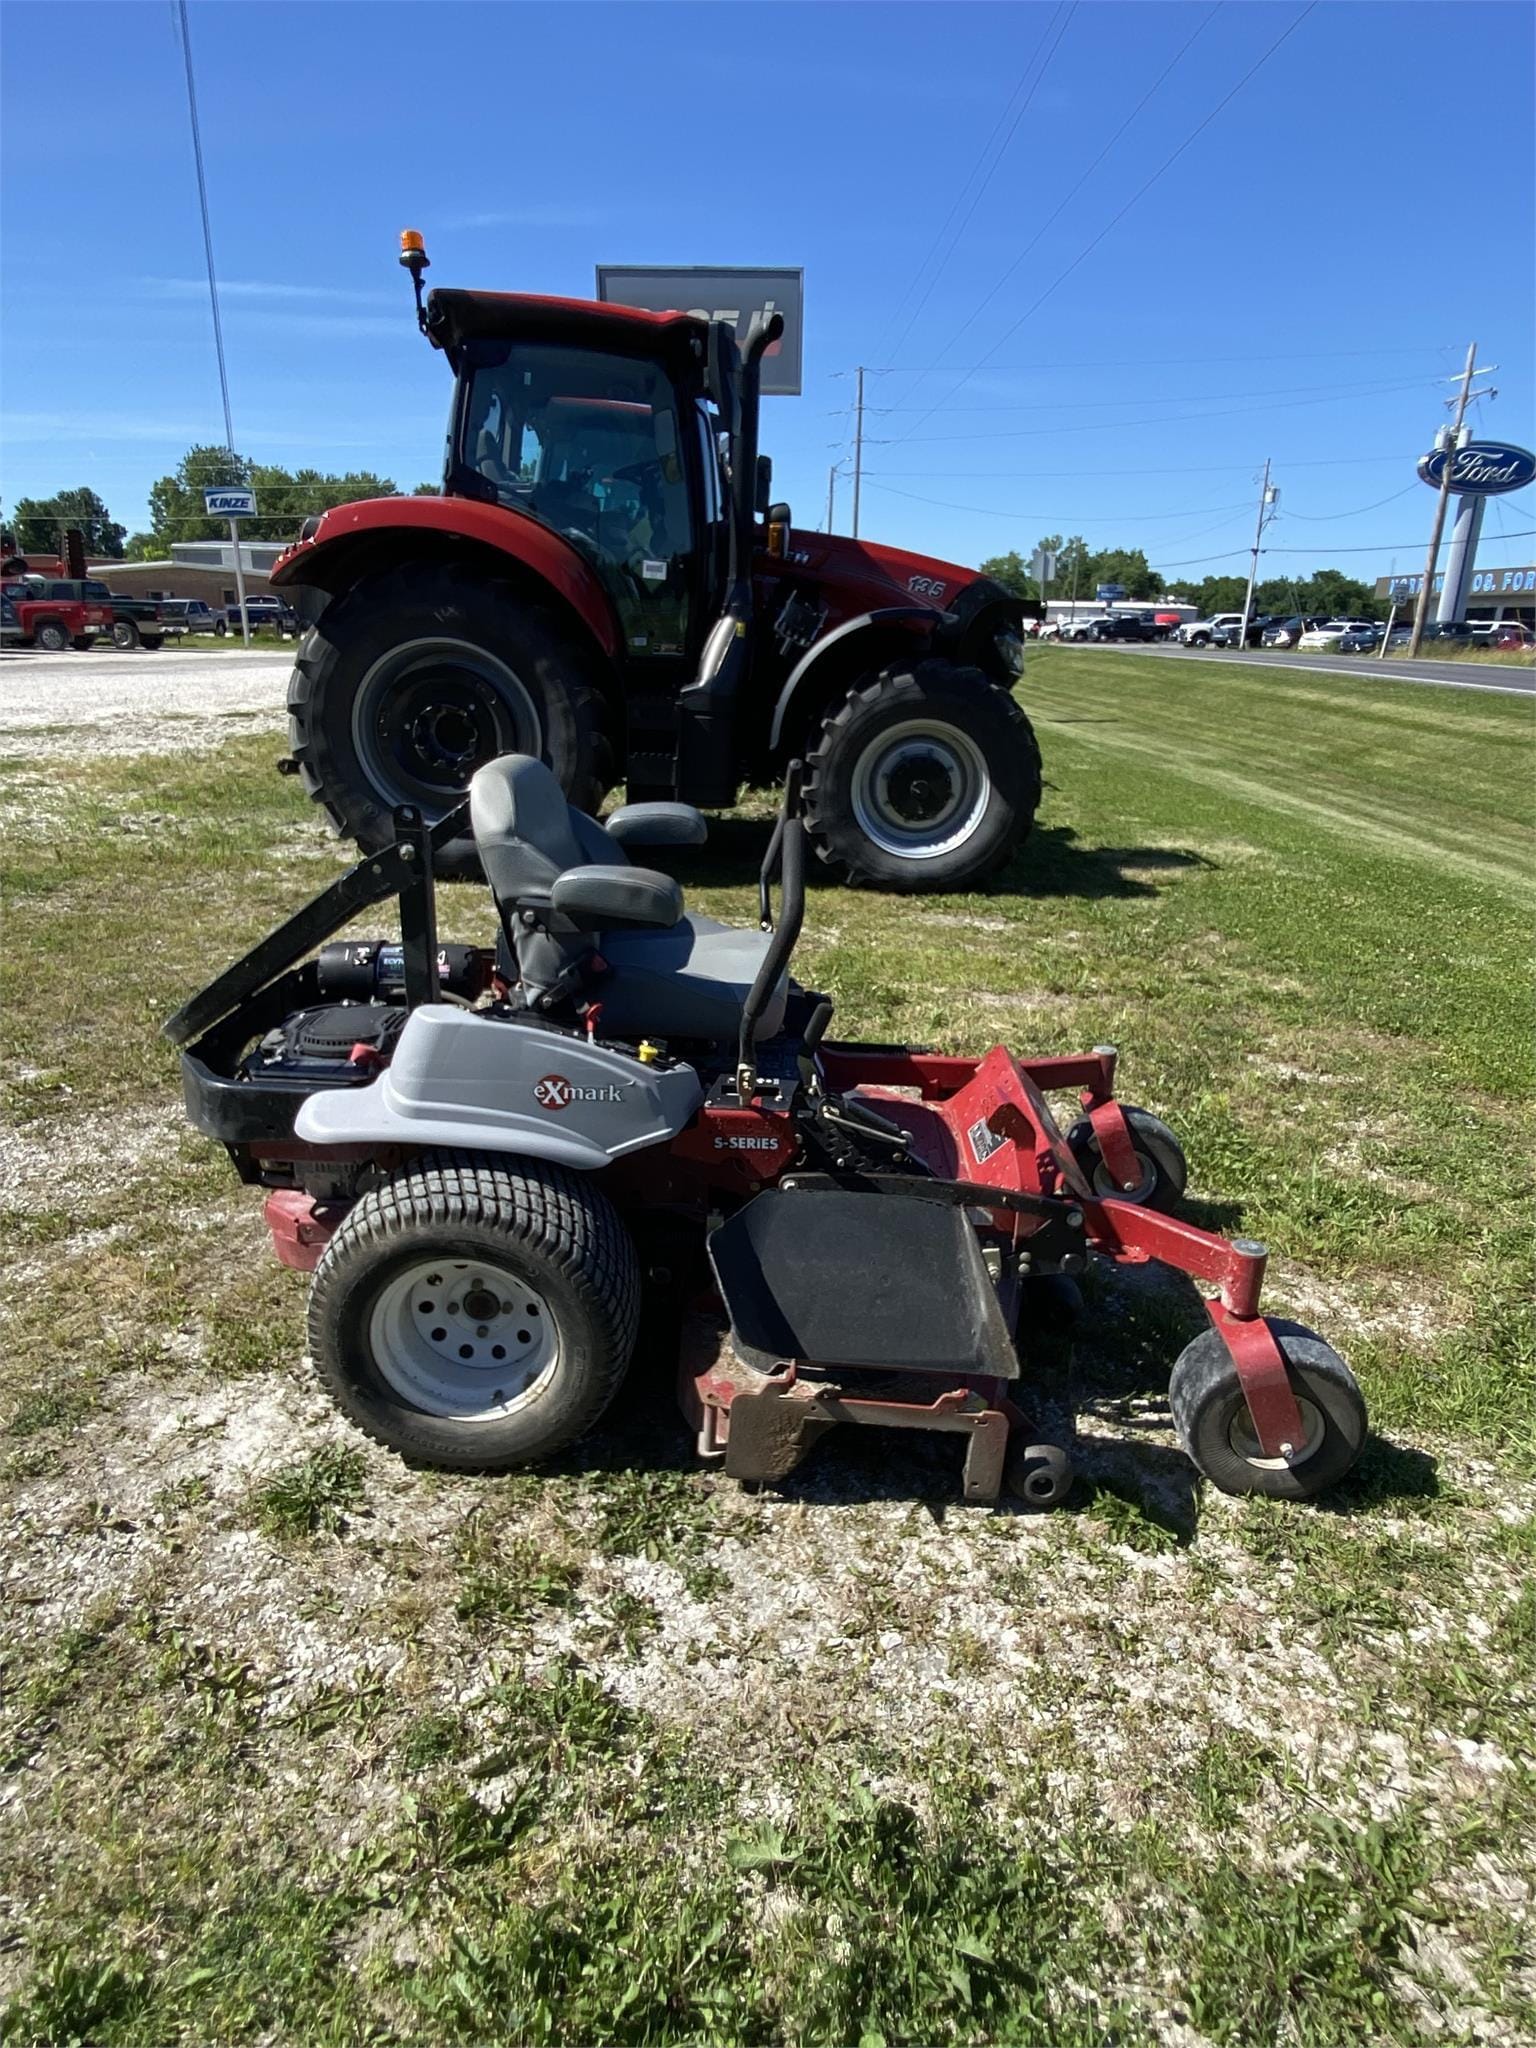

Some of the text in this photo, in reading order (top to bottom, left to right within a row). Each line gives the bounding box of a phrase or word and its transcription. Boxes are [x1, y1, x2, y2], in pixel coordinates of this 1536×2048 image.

[1451, 450, 1520, 483] Ford
[208, 497, 251, 509] KINZE
[908, 575, 947, 598] 135
[1501, 571, 1536, 592] FOR
[714, 1136, 779, 1150] S-SERIES
